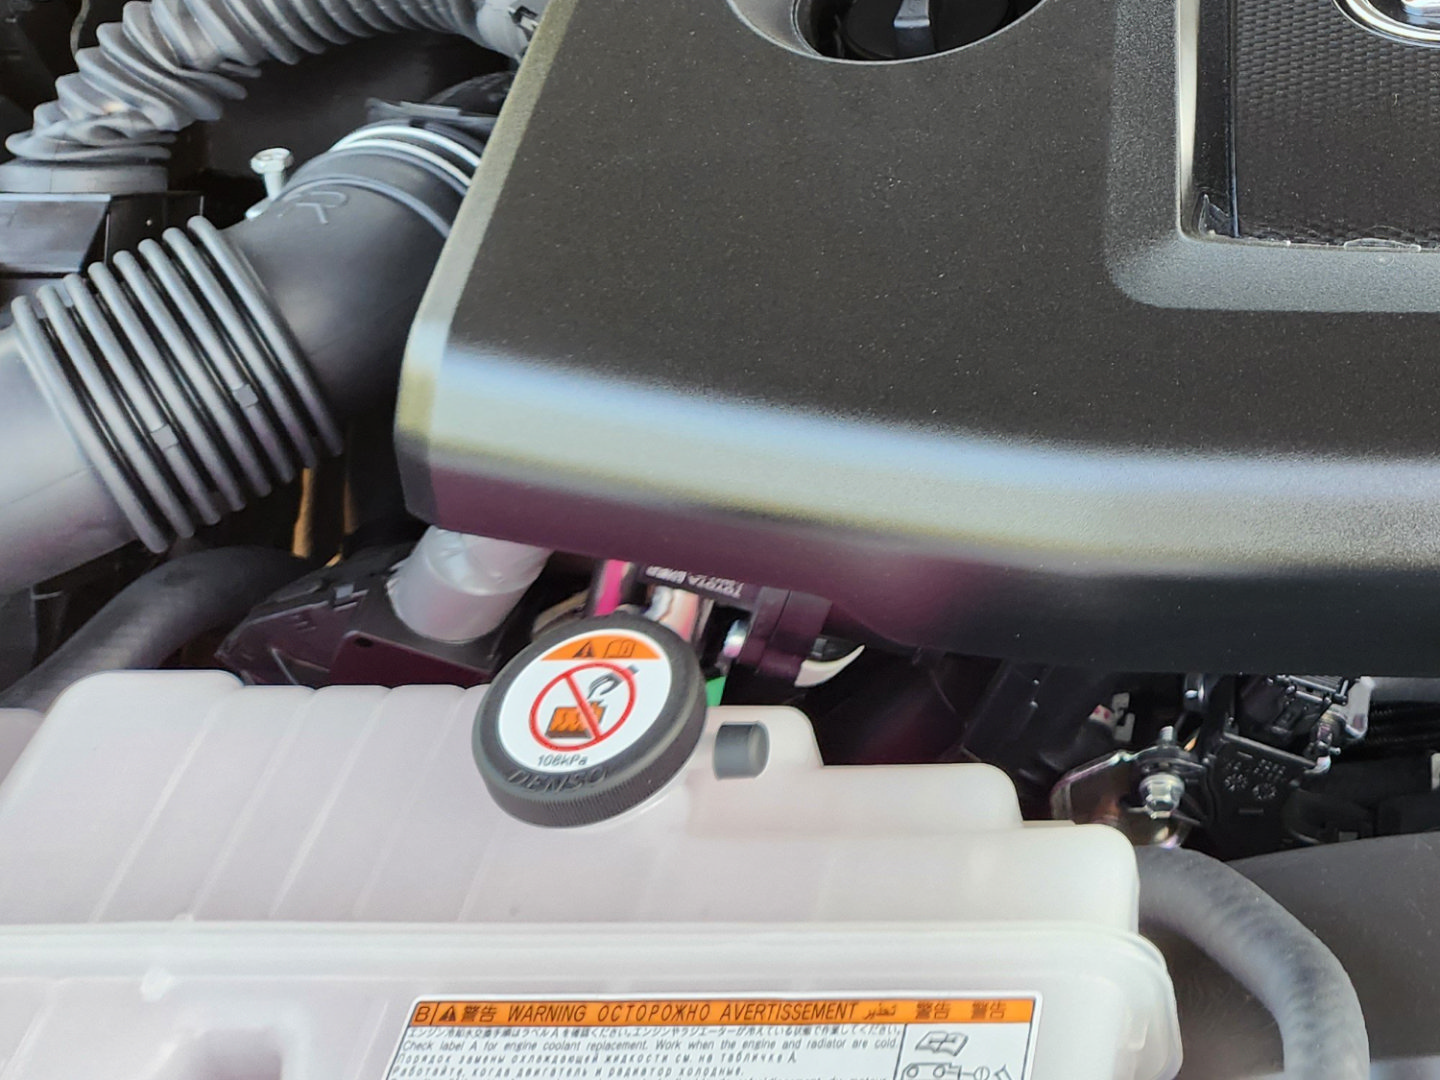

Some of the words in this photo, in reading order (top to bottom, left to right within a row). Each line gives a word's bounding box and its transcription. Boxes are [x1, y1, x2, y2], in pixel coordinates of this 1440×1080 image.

[507, 766, 609, 793] DENSO
[414, 1005, 431, 1023] B
[461, 1004, 498, 1023] 警告
[507, 1004, 587, 1023] WARNING
[597, 1003, 711, 1023] ОСТОРОЖНО
[719, 1001, 859, 1021] AVERTISSEMENT
[863, 1002, 897, 1020] تحذير
[914, 1001, 952, 1020] 警告
[403, 1040, 434, 1051] Check
[440, 1040, 464, 1050] label
[469, 1041, 478, 1050] A
[483, 1040, 497, 1050] for
[503, 1040, 537, 1052] engine
[543, 1040, 581, 1050] coolant
[586, 1040, 648, 1052] replacement.
[655, 1039, 681, 1050] Work
[688, 1040, 714, 1050] when
[720, 1039, 736, 1049] the
[742, 1038, 776, 1050] engine
[782, 1038, 802, 1049] and
[806, 1038, 846, 1049] radiator
[852, 1040, 868, 1049] are
[874, 1037, 898, 1049] cold.
[397, 1054, 452, 1065] Порядок
[458, 1054, 506, 1064] замены
[511, 1052, 598, 1065] охлаждающей
[604, 1054, 668, 1065] жидкости
[698, 1054, 713, 1064] на
[720, 1051, 783, 1064] табличке
[472, 1067, 510, 1077] когда
[516, 1067, 587, 1077] двигатель
[594, 1067, 602, 1076] и
[608, 1067, 672, 1078] радиатор
[678, 1066, 744, 1078] холодные.
